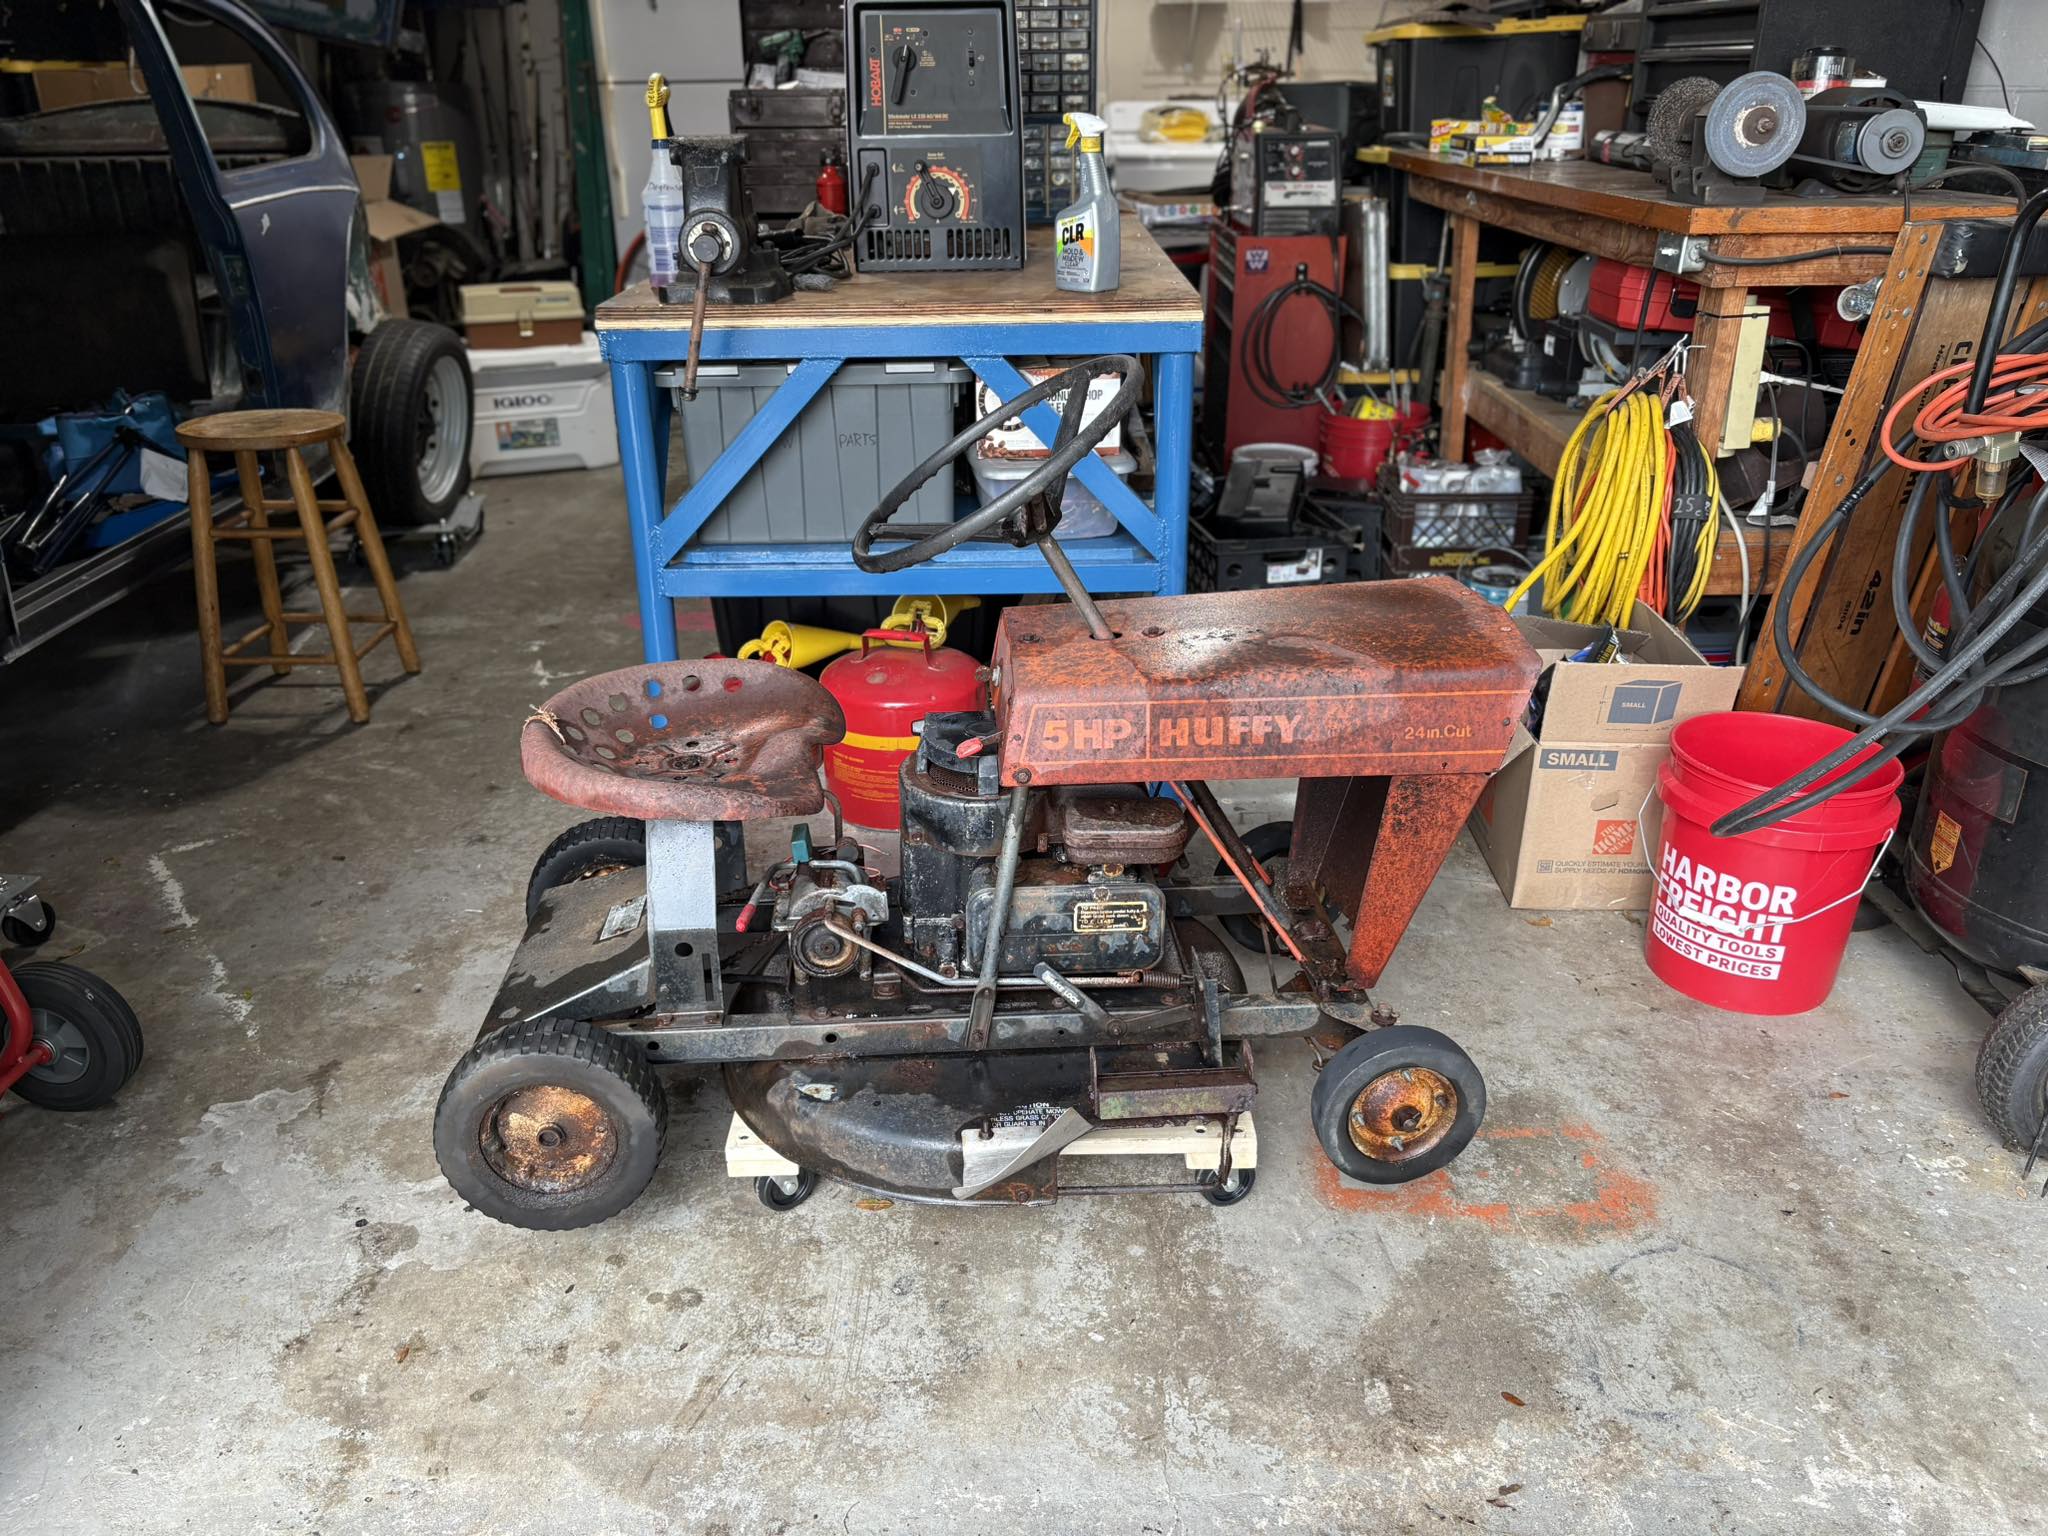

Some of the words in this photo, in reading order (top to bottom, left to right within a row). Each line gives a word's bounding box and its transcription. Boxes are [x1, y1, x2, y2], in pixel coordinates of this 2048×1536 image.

[870, 57, 882, 107] HOBART
[1062, 222, 1084, 246] CLR
[493, 393, 553, 410] IGLOO
[838, 432, 879, 449] PARTS
[1673, 497, 1696, 513] 25
[1850, 569, 1882, 636] 42in
[1042, 718, 1132, 750] 5HP
[1159, 714, 1301, 747] HUFFY
[1547, 751, 1610, 767] SMALL
[1593, 820, 1634, 855] HOME
[1554, 860, 1586, 868] QUICKLY
[1587, 860, 1622, 868] ESTIMATE
[1661, 841, 1798, 915] HARBOR
[1657, 870, 1794, 944] FREIGHT
[1657, 903, 1713, 944] QUALITY
[1717, 936, 1777, 959] TOOLS
[1654, 921, 1704, 960] LOWEST
[1706, 952, 1773, 977] PRICES
[1063, 990, 1081, 1005] LOCK
